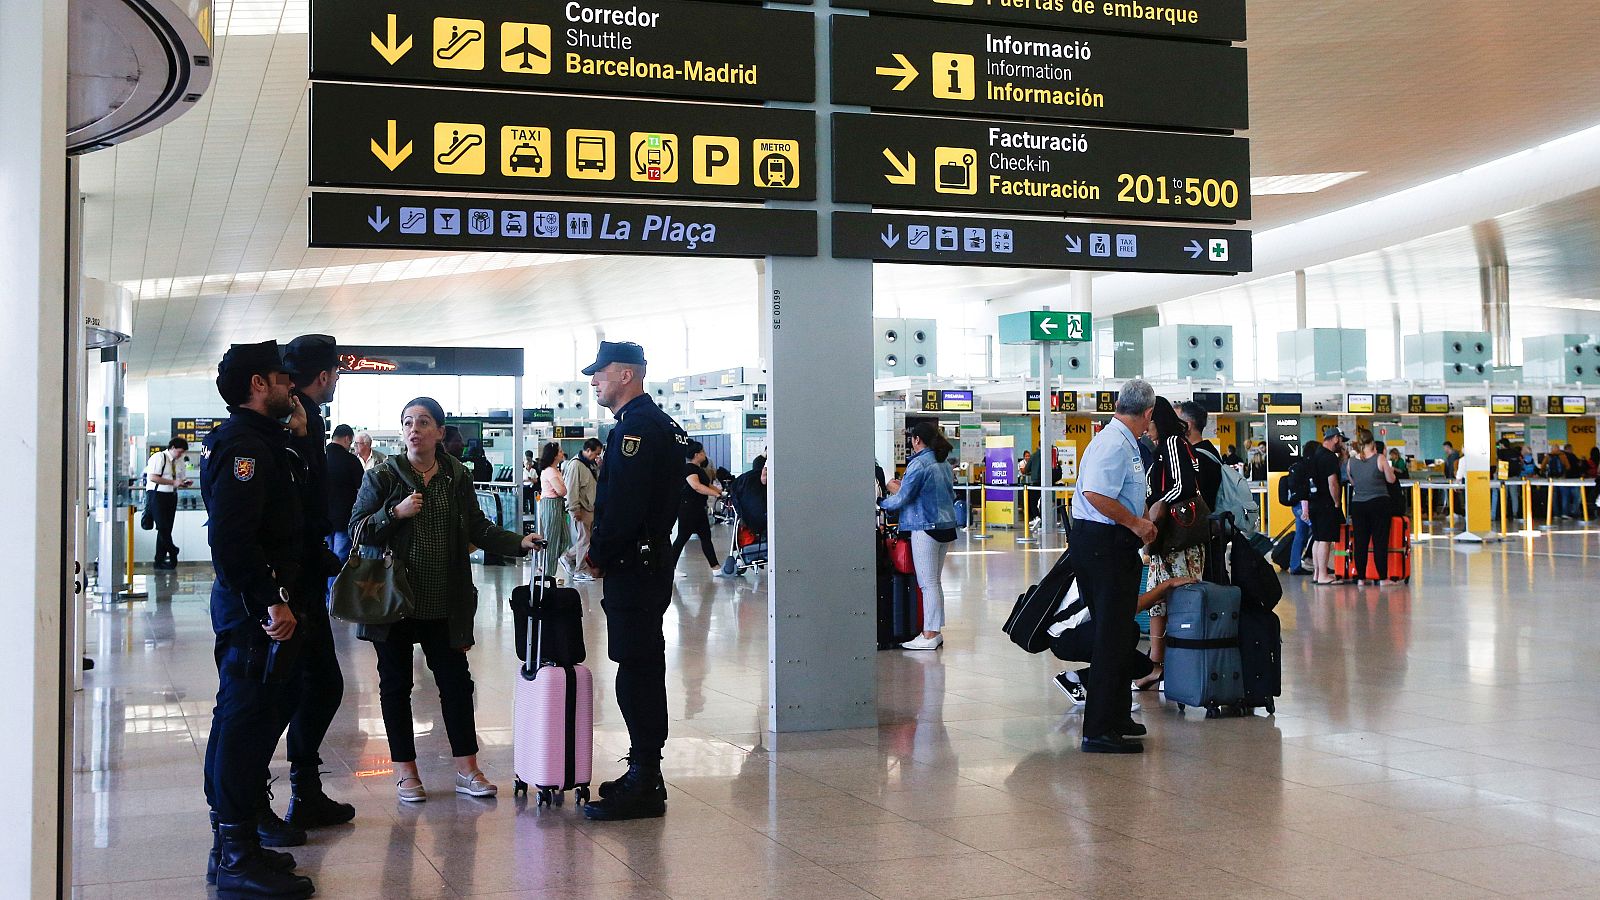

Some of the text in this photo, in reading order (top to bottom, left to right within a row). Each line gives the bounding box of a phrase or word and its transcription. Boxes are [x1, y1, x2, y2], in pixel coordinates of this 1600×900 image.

[566, 2, 659, 27] Corredor
[987, 0, 1198, 25] uertas de embarque
[567, 29, 631, 49] Shuttle
[987, 34, 1091, 60] Informació
[567, 53, 756, 84] Barcelona-Madrid
[988, 59, 1071, 80] Information
[988, 81, 1103, 107] Información
[511, 130, 540, 141] TAXI
[649, 137, 659, 145] T1
[989, 128, 1087, 152] Facturació
[761, 143, 790, 151] METRO
[706, 145, 729, 177] P
[990, 153, 1049, 172] Check-in
[648, 168, 659, 178] T2
[990, 175, 1099, 199] Facturación
[1118, 174, 1238, 208] 201 to a 500
[600, 214, 715, 249] La Plaça
[1119, 244, 1134, 252] FREE
[774, 319, 780, 329] SE
[925, 402, 938, 410] 451
[1060, 403, 1075, 411] 452
[1099, 403, 1113, 411] 453
[1224, 404, 1239, 412] 454
